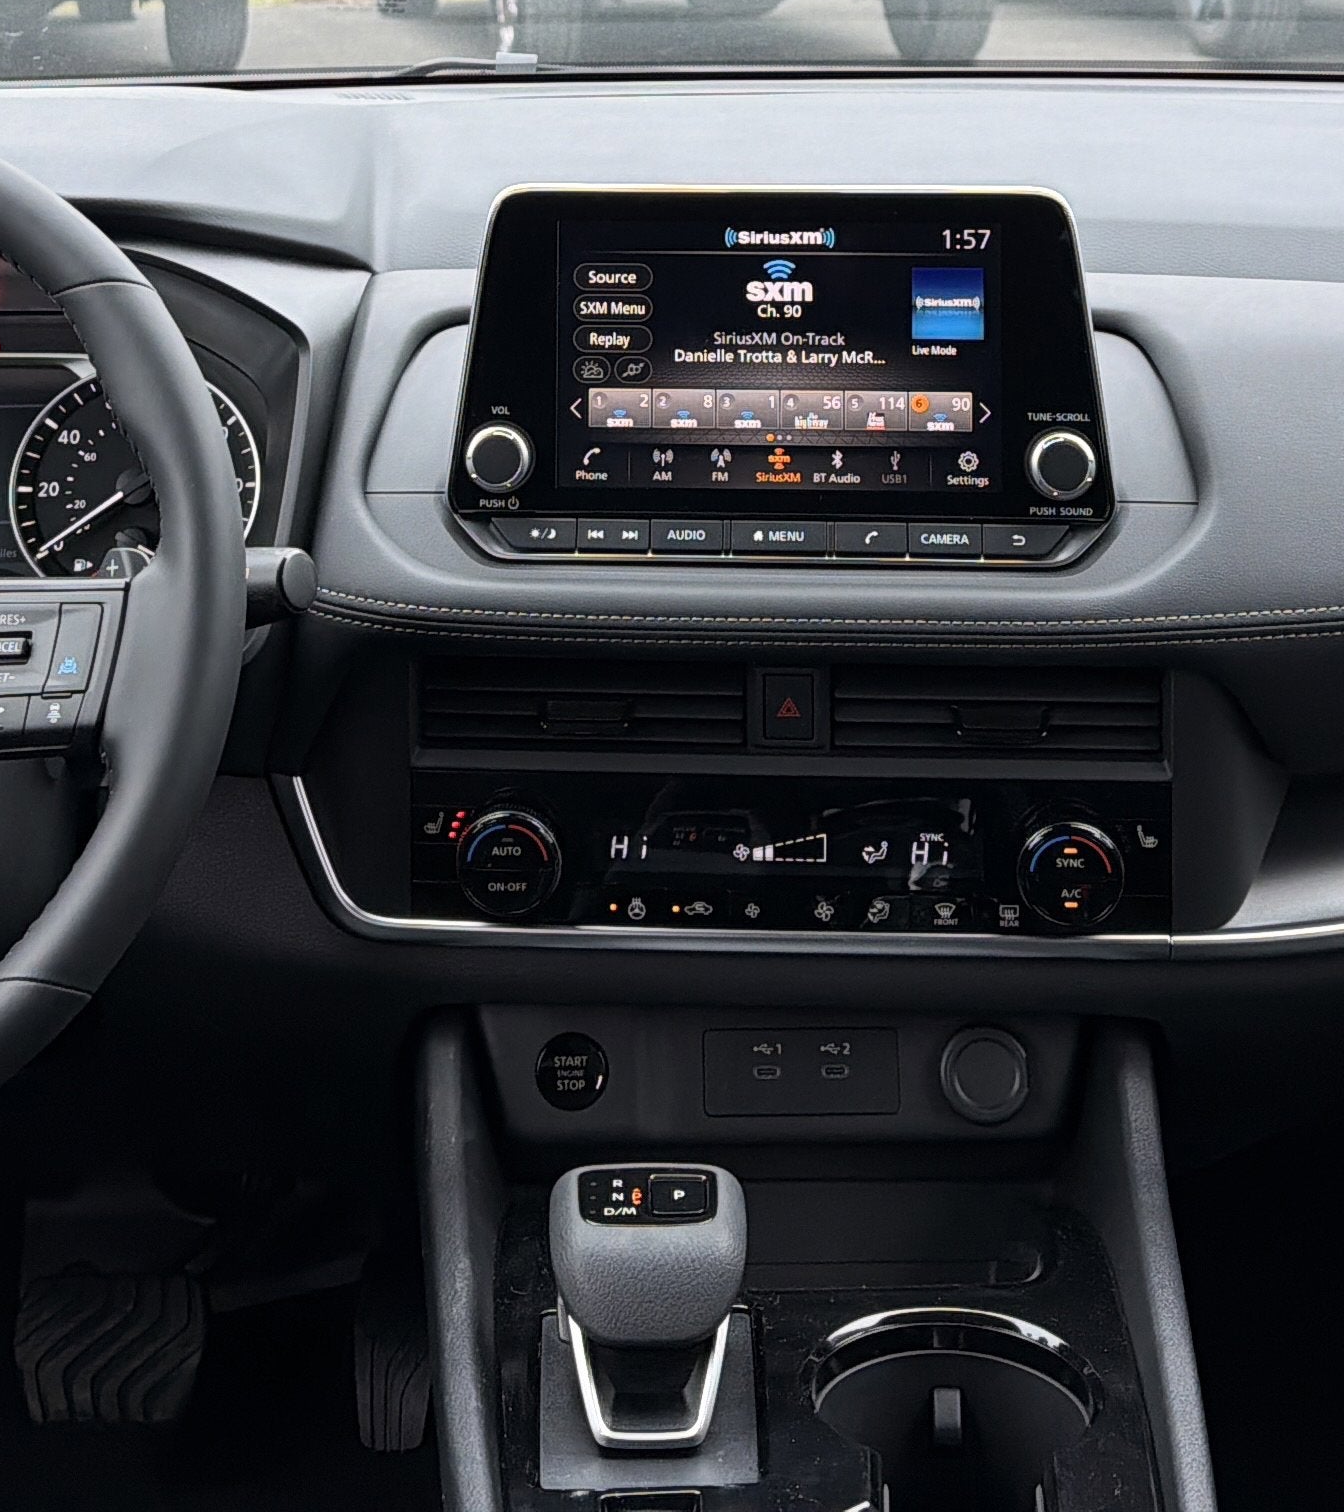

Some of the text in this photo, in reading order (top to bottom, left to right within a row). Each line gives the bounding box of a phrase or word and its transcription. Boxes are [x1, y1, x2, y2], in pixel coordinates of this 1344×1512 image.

[942, 229, 992, 250] 1:57
[588, 270, 637, 285] Source
[745, 281, 814, 303] sxm
[579, 301, 646, 315] SXM Menu
[757, 305, 802, 318] Ch. 90
[589, 332, 631, 349] Replay
[713, 332, 846, 346] SiriusXM On-Track
[911, 345, 957, 356] Live Mode
[674, 348, 886, 367] Danielle Trotta & Larry McR...
[491, 405, 510, 415] VOL
[57, 429, 81, 445] 40
[83, 452, 97, 462] 60
[575, 470, 608, 481] Phone
[653, 470, 672, 481] AM
[712, 471, 729, 482] FM
[755, 471, 802, 483] SiriusXM
[813, 472, 861, 484] BT Audio
[881, 473, 907, 484] USB1
[946, 474, 989, 487] Settings
[37, 481, 60, 497] 20
[73, 499, 86, 509] 20
[479, 498, 505, 508] PUSH
[1029, 506, 1093, 517] PUSH SOUND
[667, 529, 706, 541] AUDIO
[768, 530, 805, 542] MENU
[920, 533, 969, 545] CAMERA
[0, 614, 26, 626] RES+
[919, 833, 944, 842] SYNC
[491, 846, 522, 856] AUTO
[1055, 858, 1085, 869] SYNC
[1061, 888, 1081, 899] A/C
[933, 918, 959, 927] FRONT
[999, 919, 1020, 928] REAR
[553, 1055, 588, 1068] START
[556, 1079, 586, 1092] STOP
[612, 1179, 623, 1188] R
[611, 1192, 624, 1201] N
[673, 1190, 685, 1200] P
[603, 1207, 637, 1216] D/M
